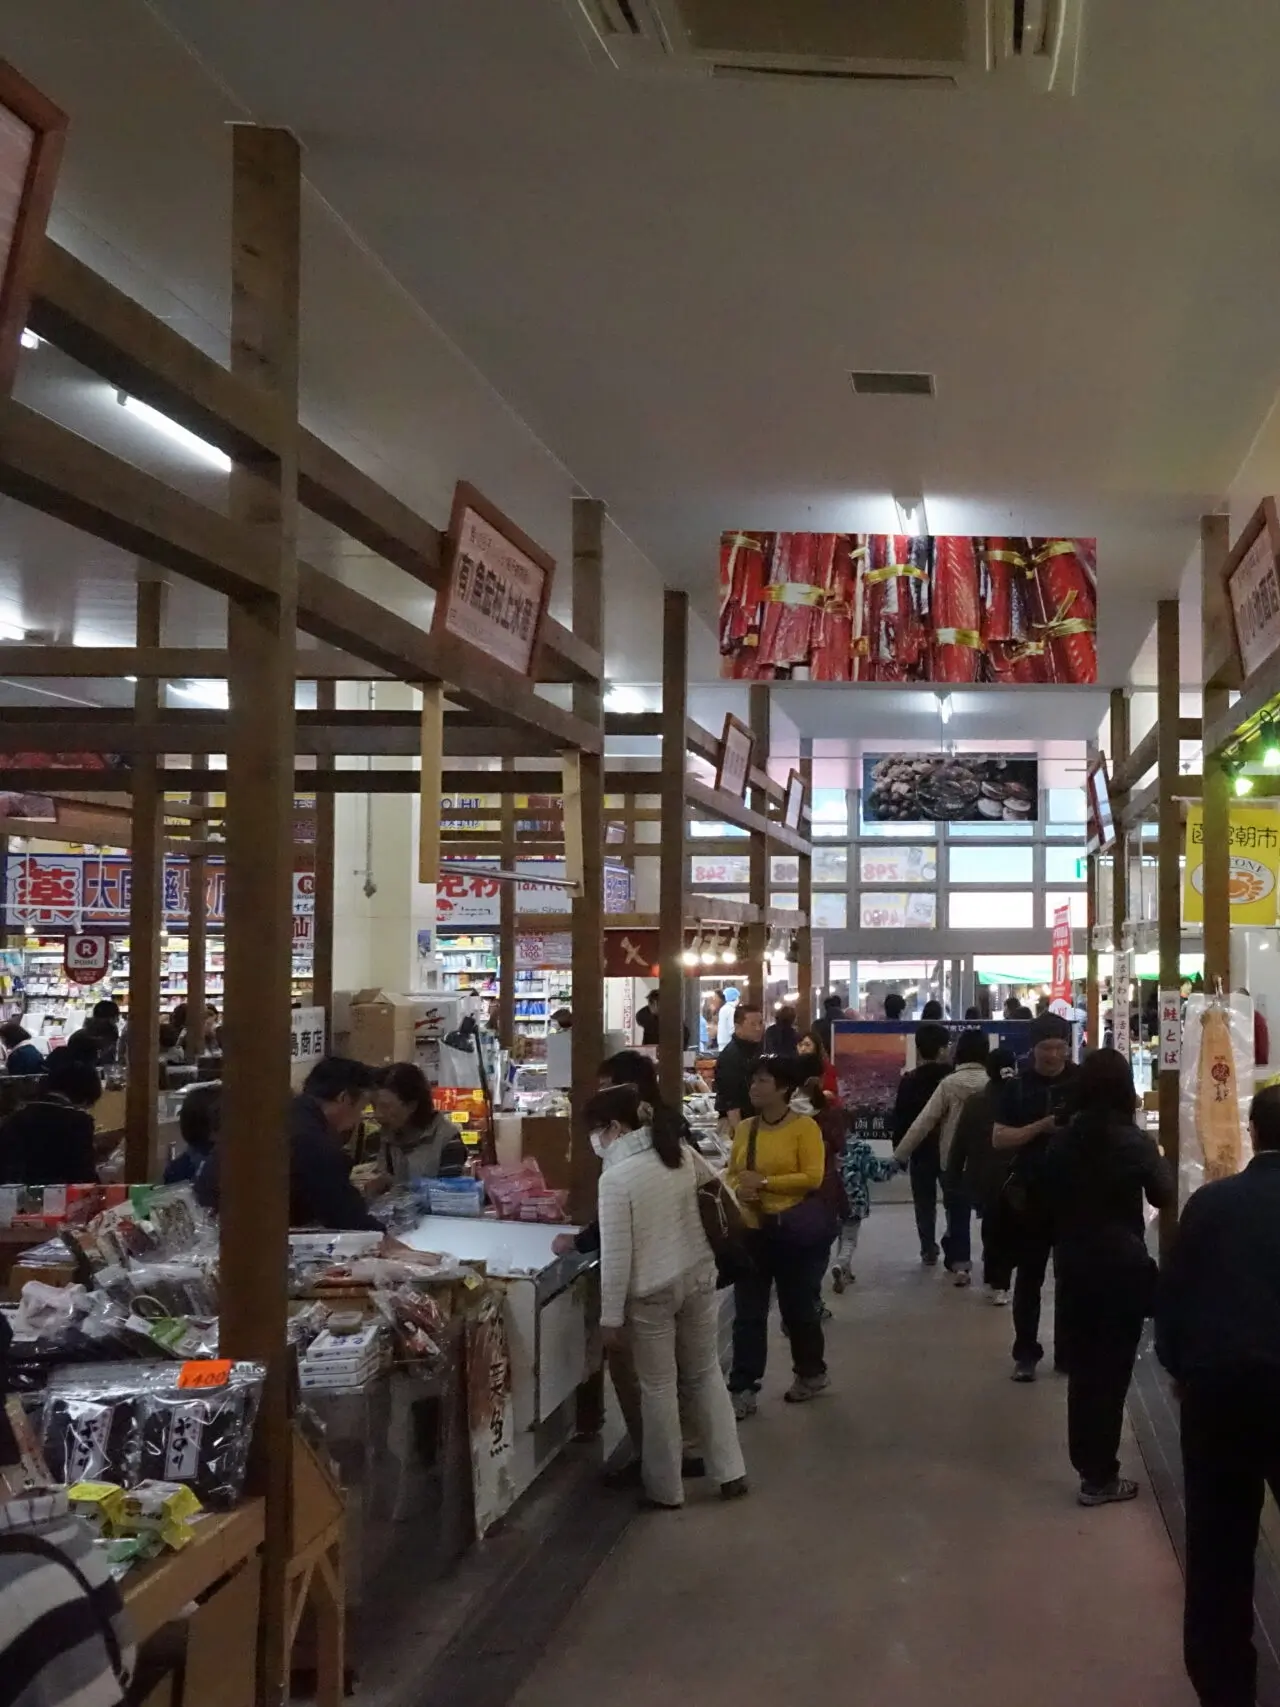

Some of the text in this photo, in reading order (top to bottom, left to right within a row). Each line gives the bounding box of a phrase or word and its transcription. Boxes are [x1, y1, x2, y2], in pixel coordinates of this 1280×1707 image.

[1192, 823, 1279, 848] 函朝市
[1162, 1005, 1179, 1065] 鮭とば
